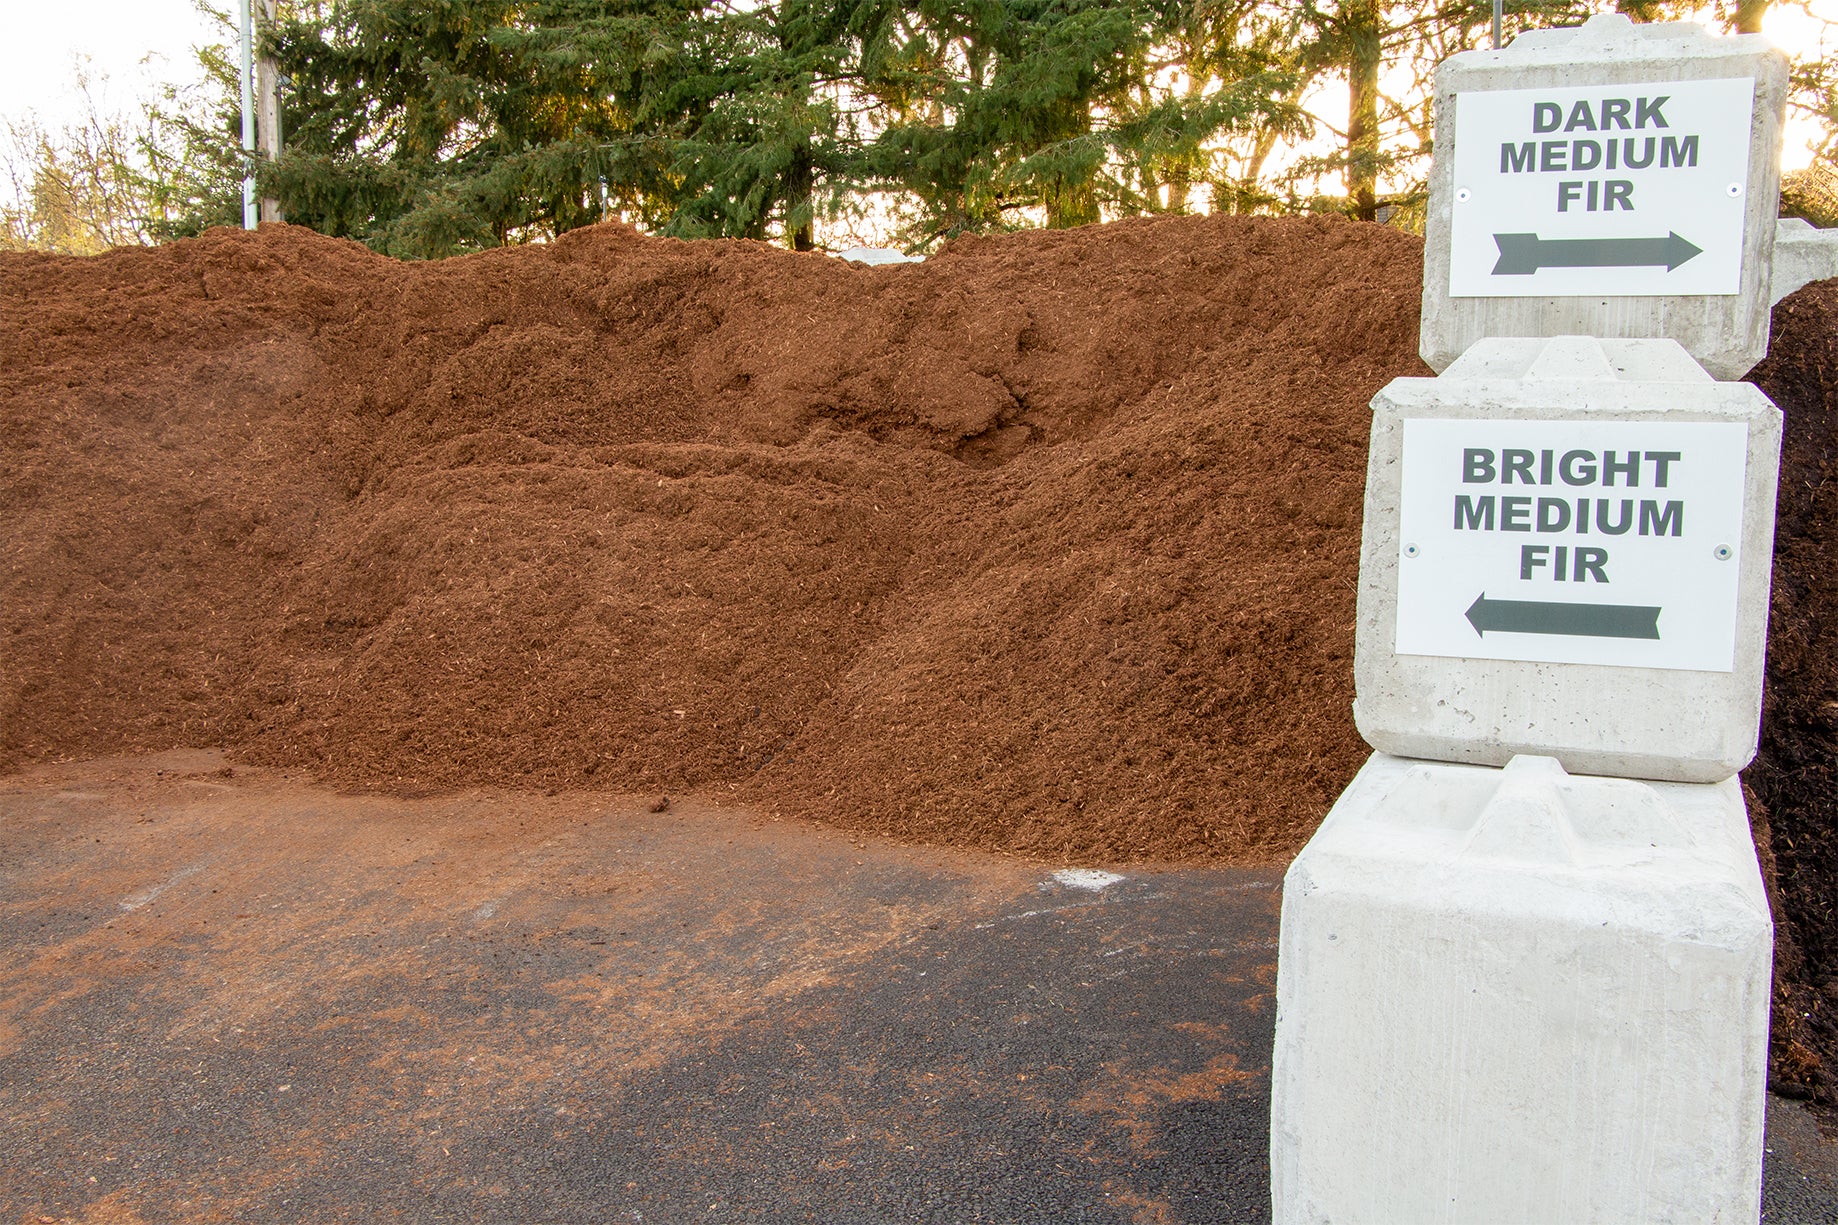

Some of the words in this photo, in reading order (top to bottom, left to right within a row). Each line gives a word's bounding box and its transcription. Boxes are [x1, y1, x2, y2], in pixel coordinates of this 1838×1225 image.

[1534, 97, 1670, 133] DARK
[1500, 136, 1699, 173] MEDIUM
[1557, 180, 1635, 212] FIR
[1462, 448, 1681, 488] BRIGHT
[1453, 495, 1684, 537] MEDIUM
[1520, 545, 1610, 583] FIR
